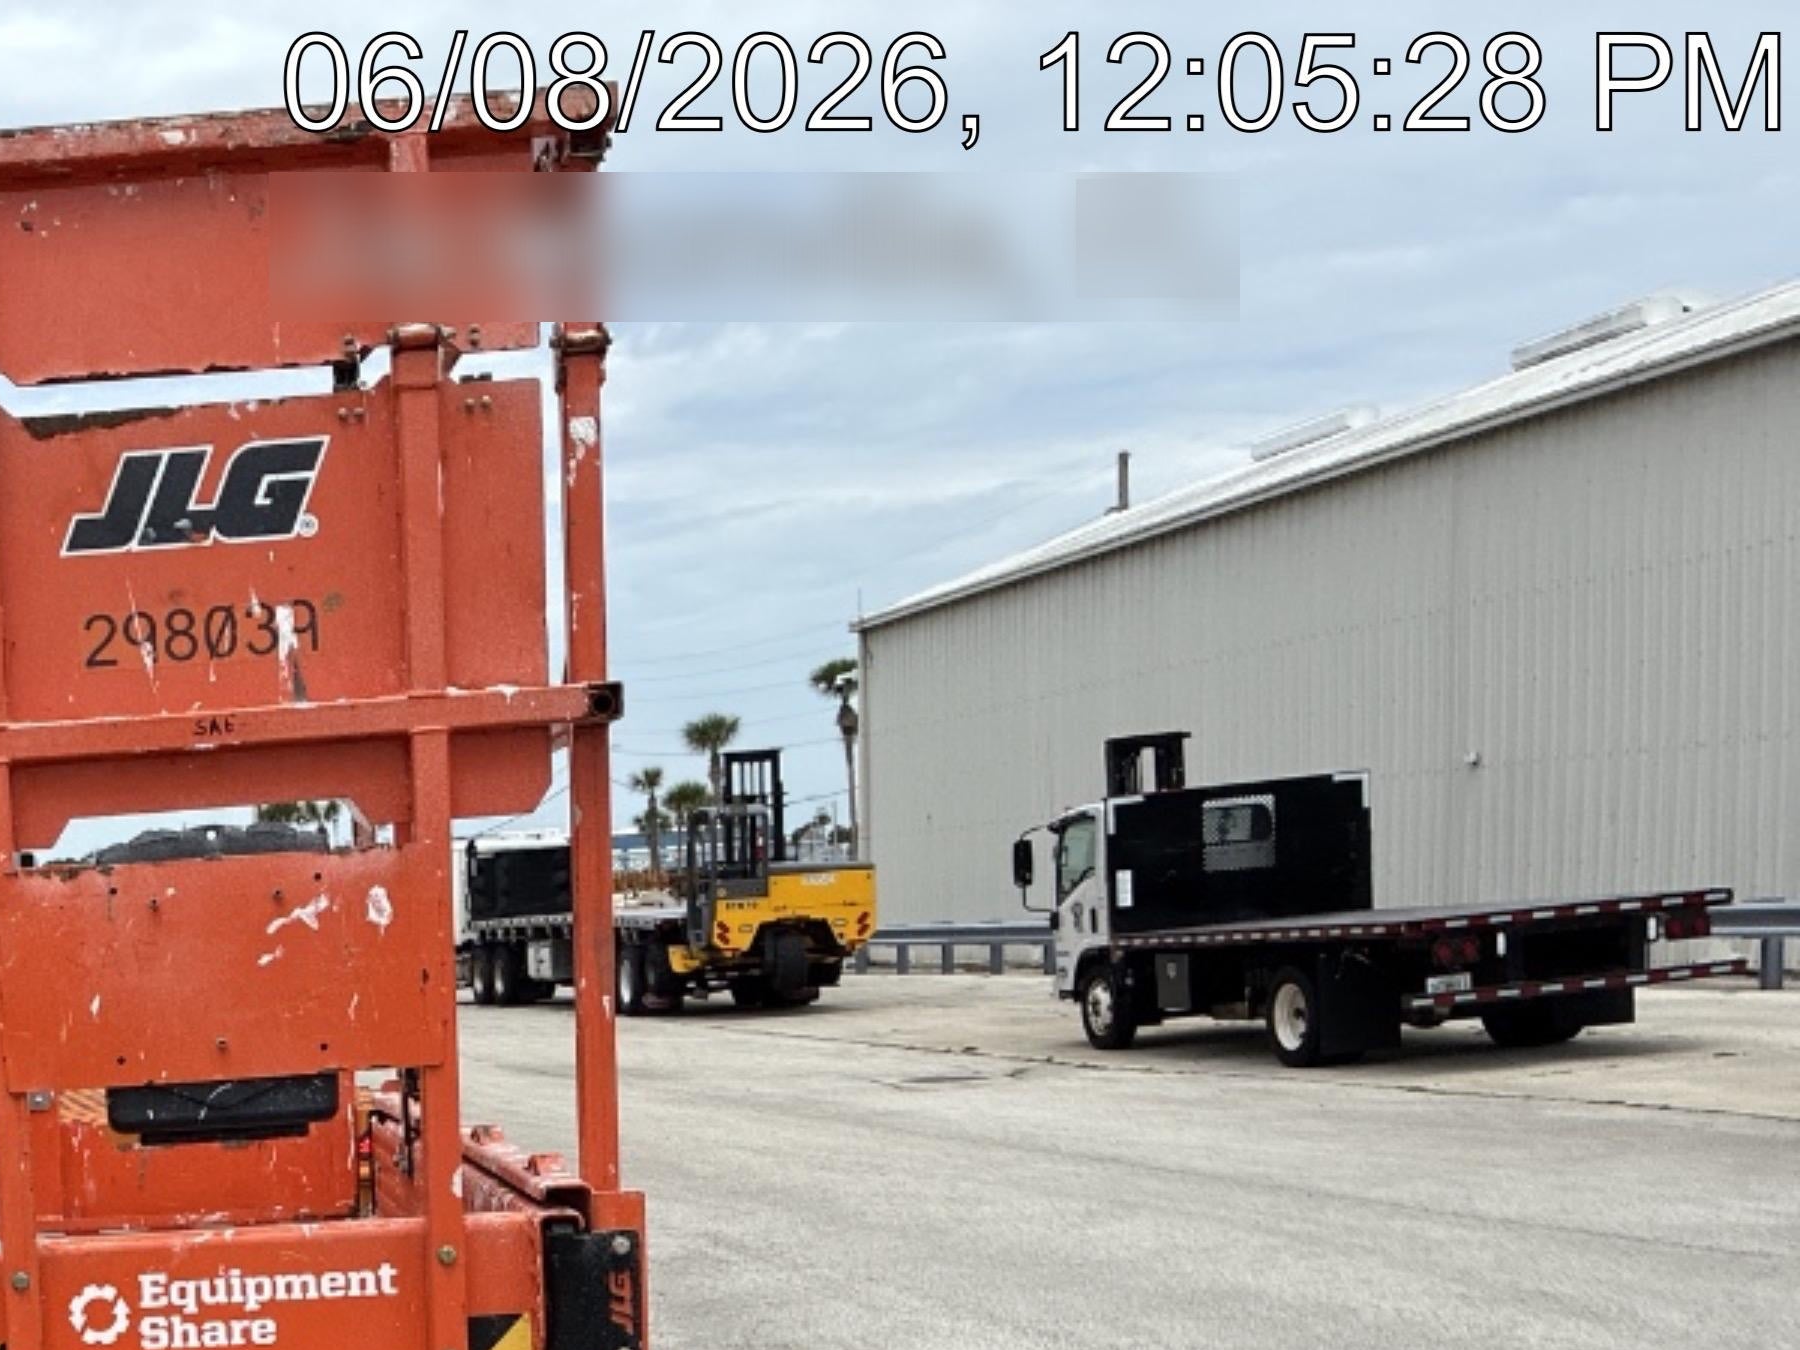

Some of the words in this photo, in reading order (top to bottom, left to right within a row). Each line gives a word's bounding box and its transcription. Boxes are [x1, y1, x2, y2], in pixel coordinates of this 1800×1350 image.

[60, 434, 331, 558] JLG
[83, 598, 319, 668] 298039
[138, 1262, 398, 1314] Equipment
[139, 1315, 278, 1350] Share
